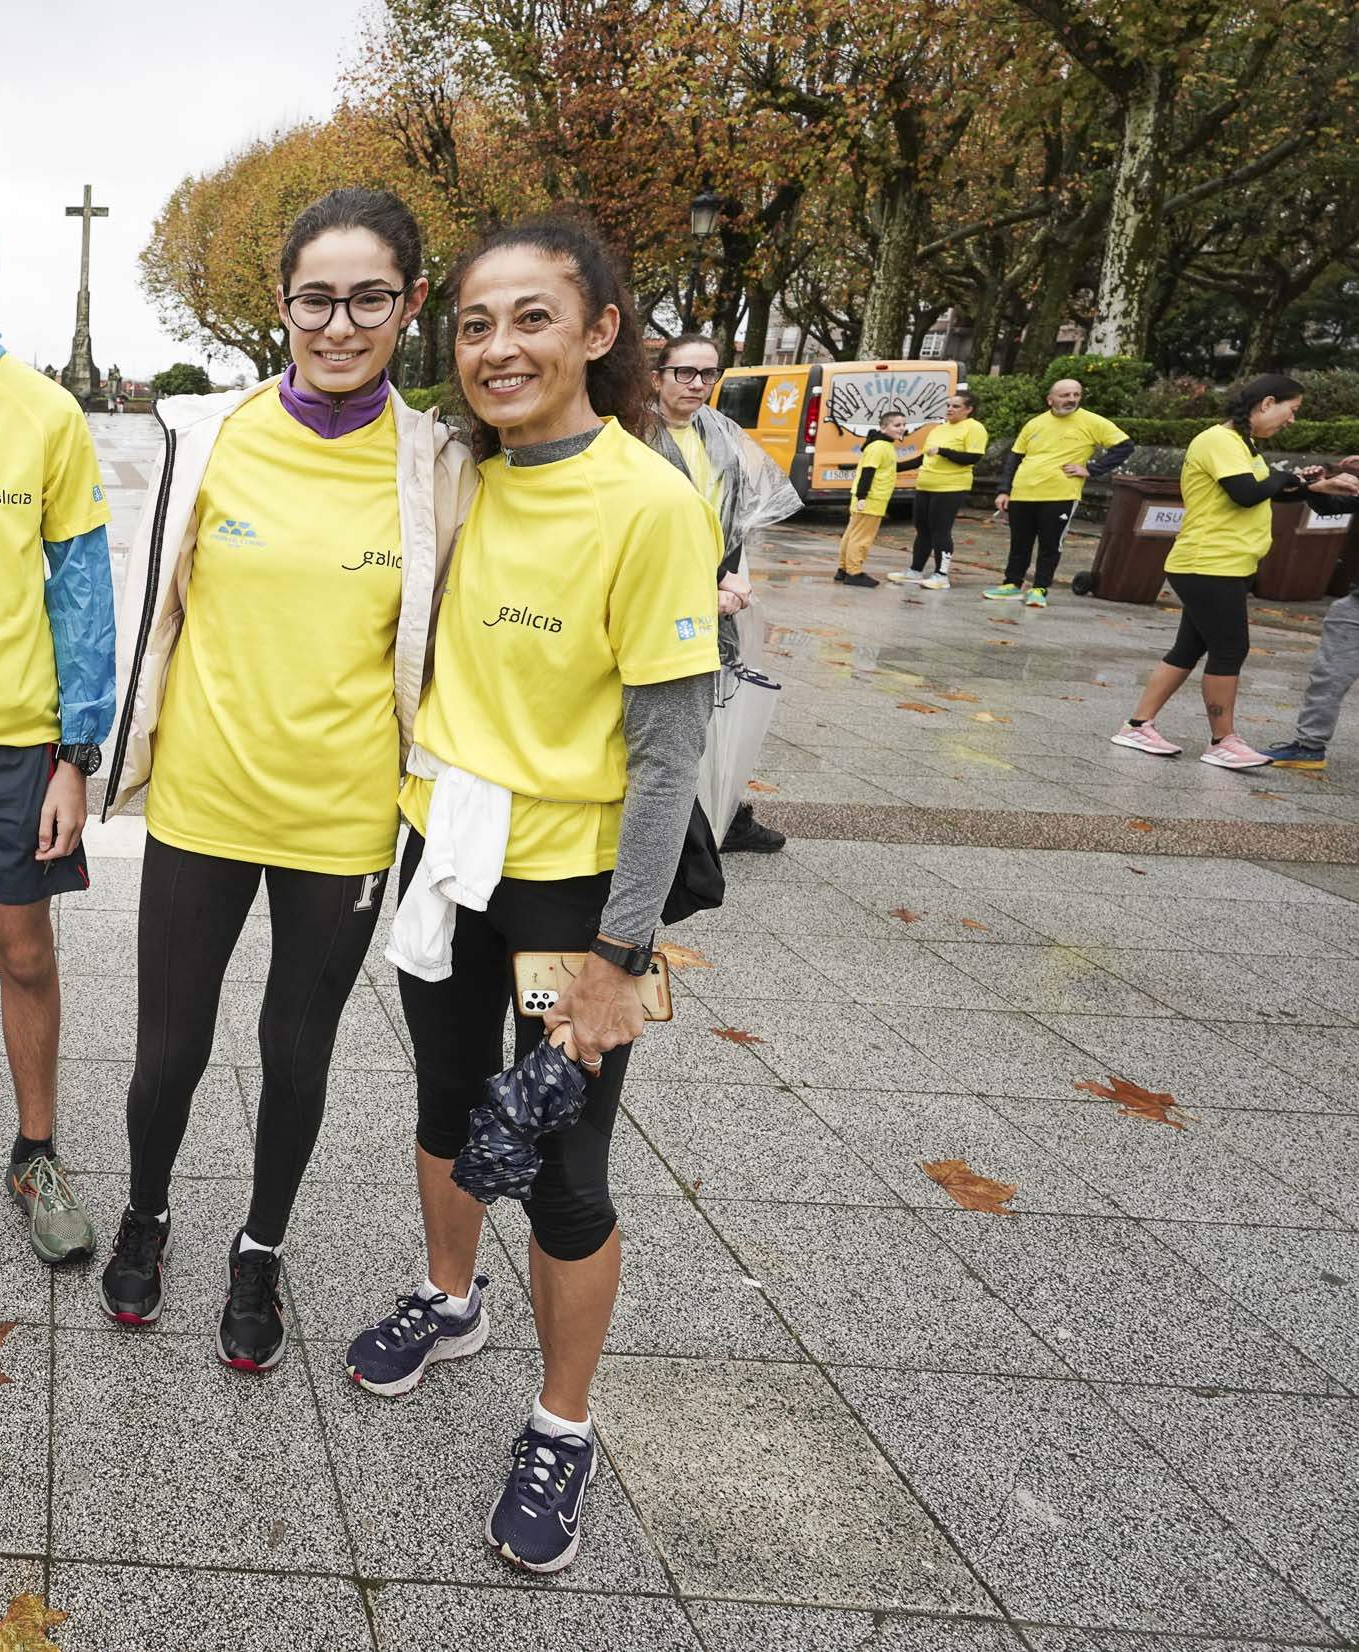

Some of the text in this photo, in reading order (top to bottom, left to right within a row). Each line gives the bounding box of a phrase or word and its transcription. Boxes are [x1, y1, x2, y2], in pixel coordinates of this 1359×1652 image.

[864, 373, 923, 397] rivel
[1155, 512, 1182, 523] RSU
[483, 606, 562, 632] galicia
